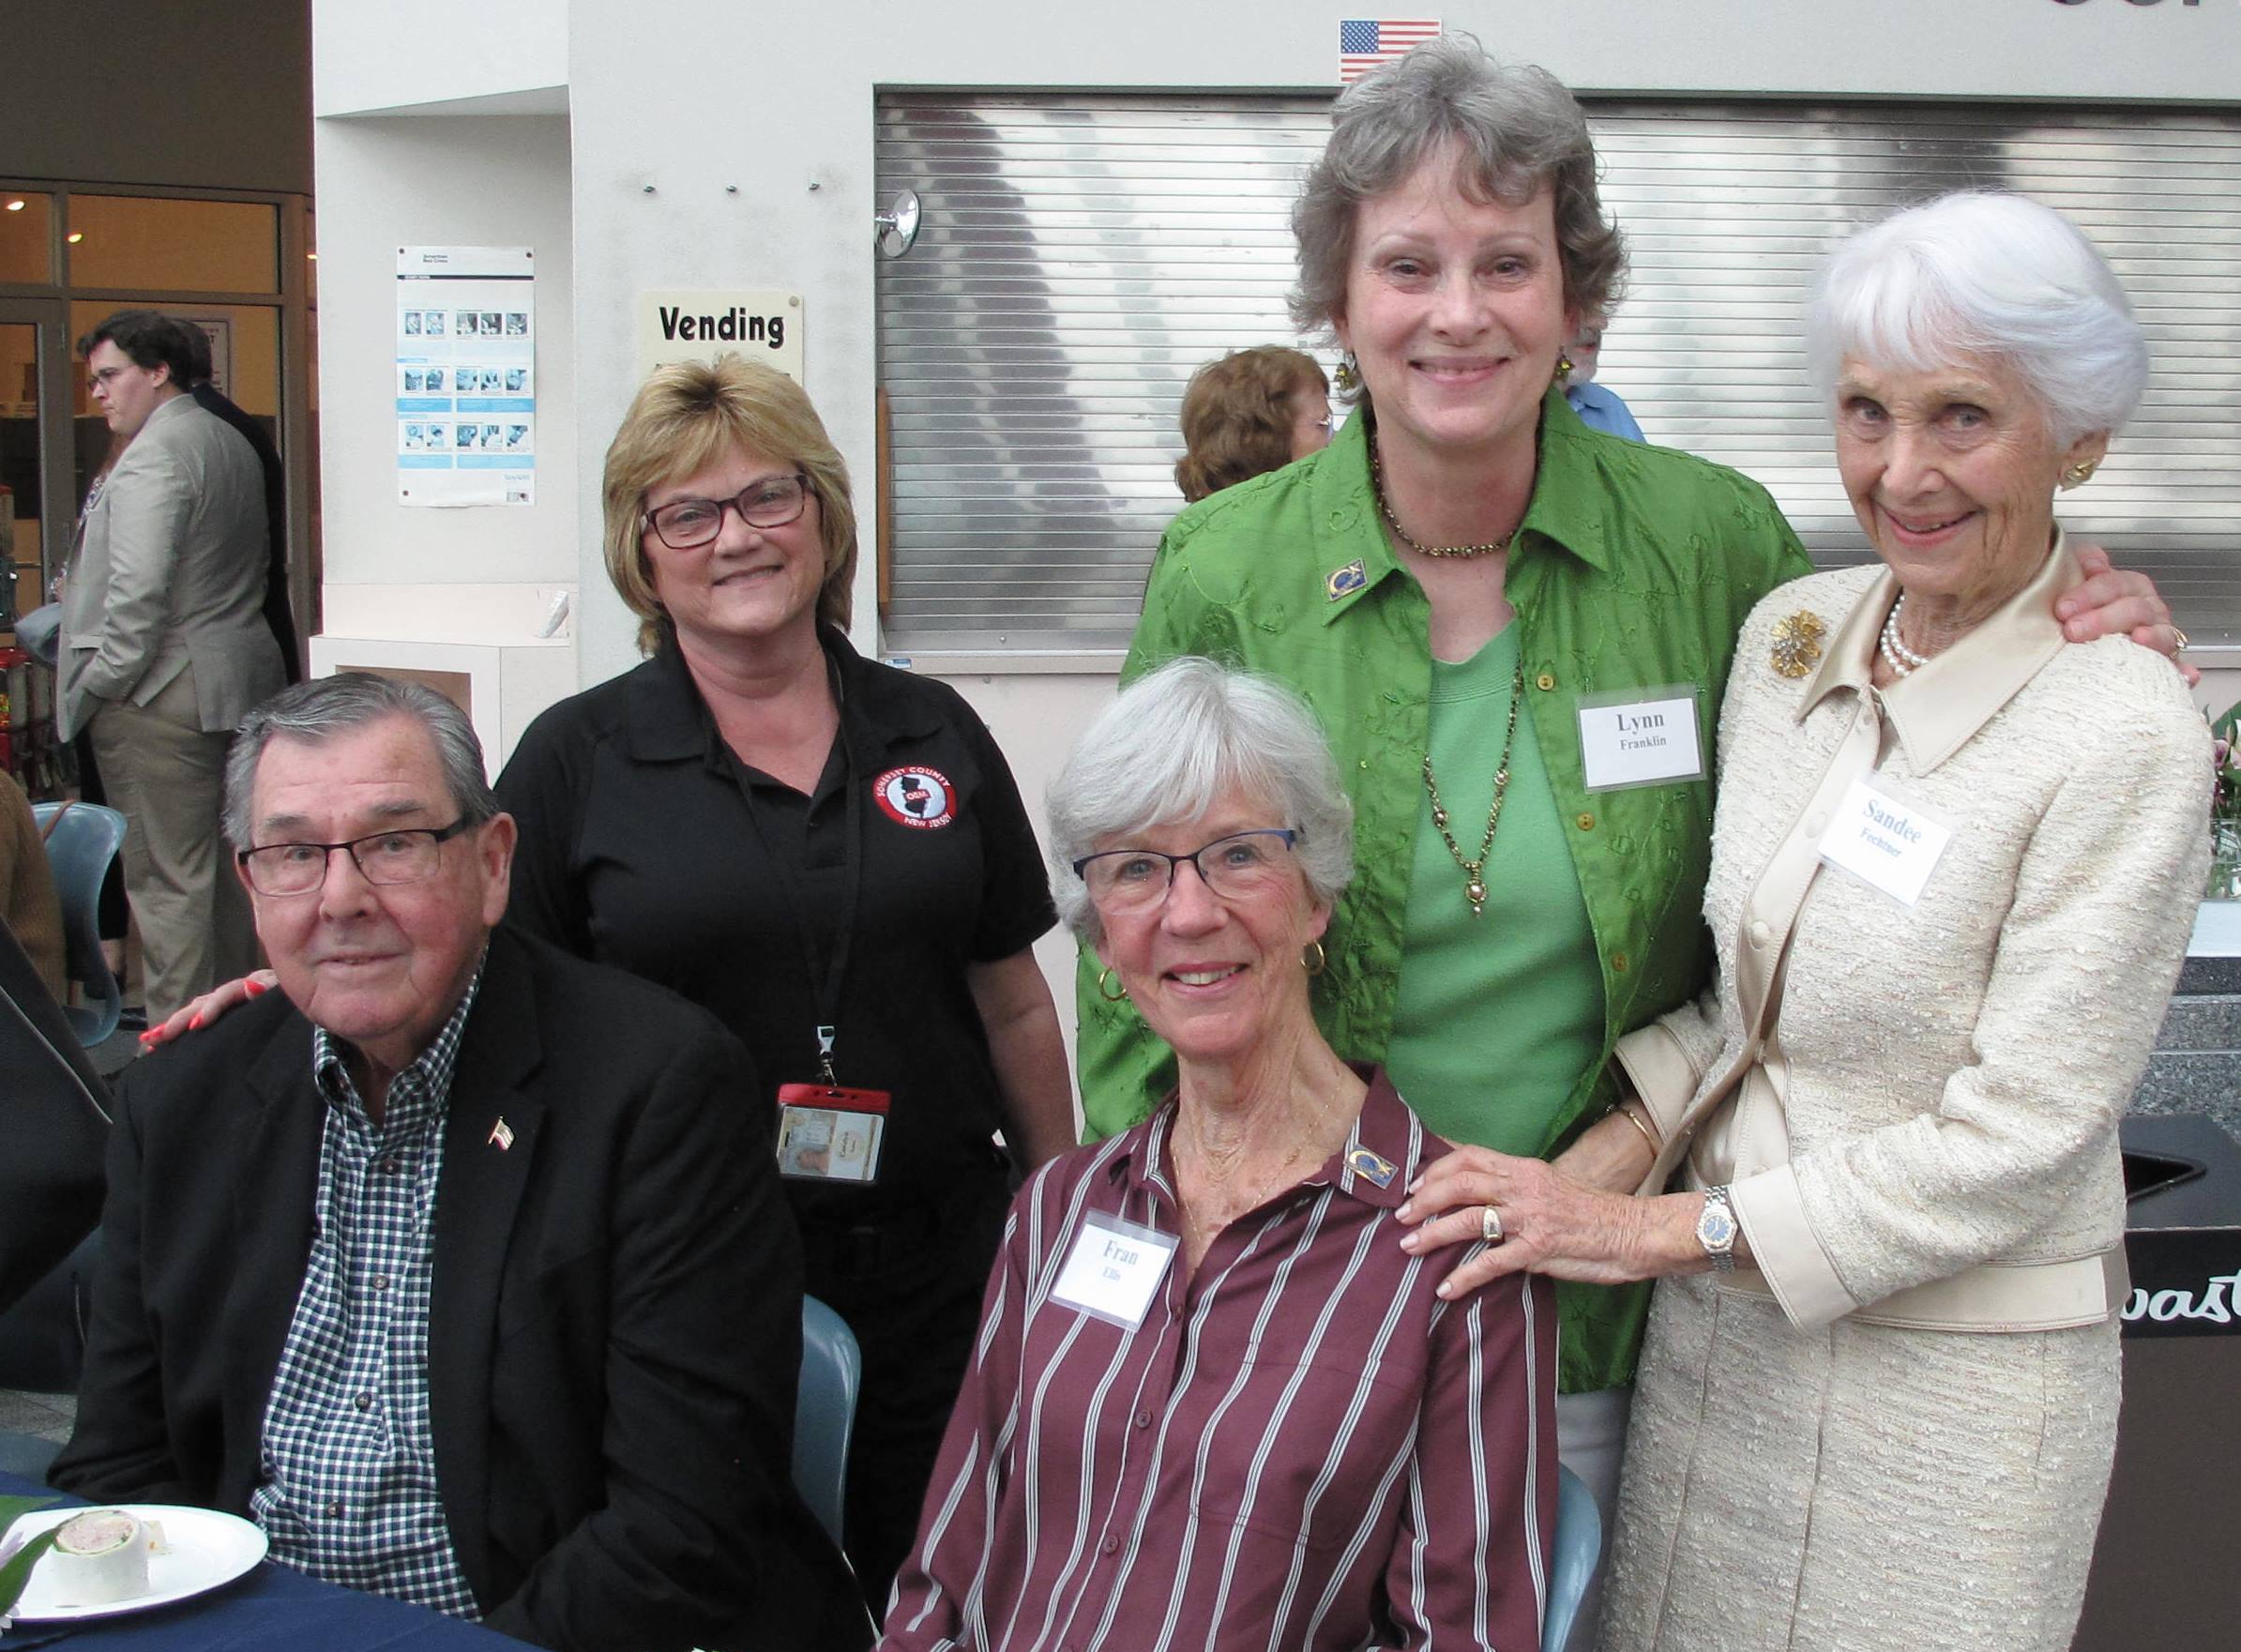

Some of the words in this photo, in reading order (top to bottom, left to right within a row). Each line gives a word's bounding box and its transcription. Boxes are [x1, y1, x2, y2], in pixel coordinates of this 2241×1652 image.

[659, 306, 785, 350] Vending
[1616, 713, 1665, 735] Lynn
[1620, 735, 1667, 750] Franklin
[908, 766, 951, 787] COUNTY
[1862, 798, 1922, 843] Sandee
[1103, 1239, 1139, 1266] Fran
